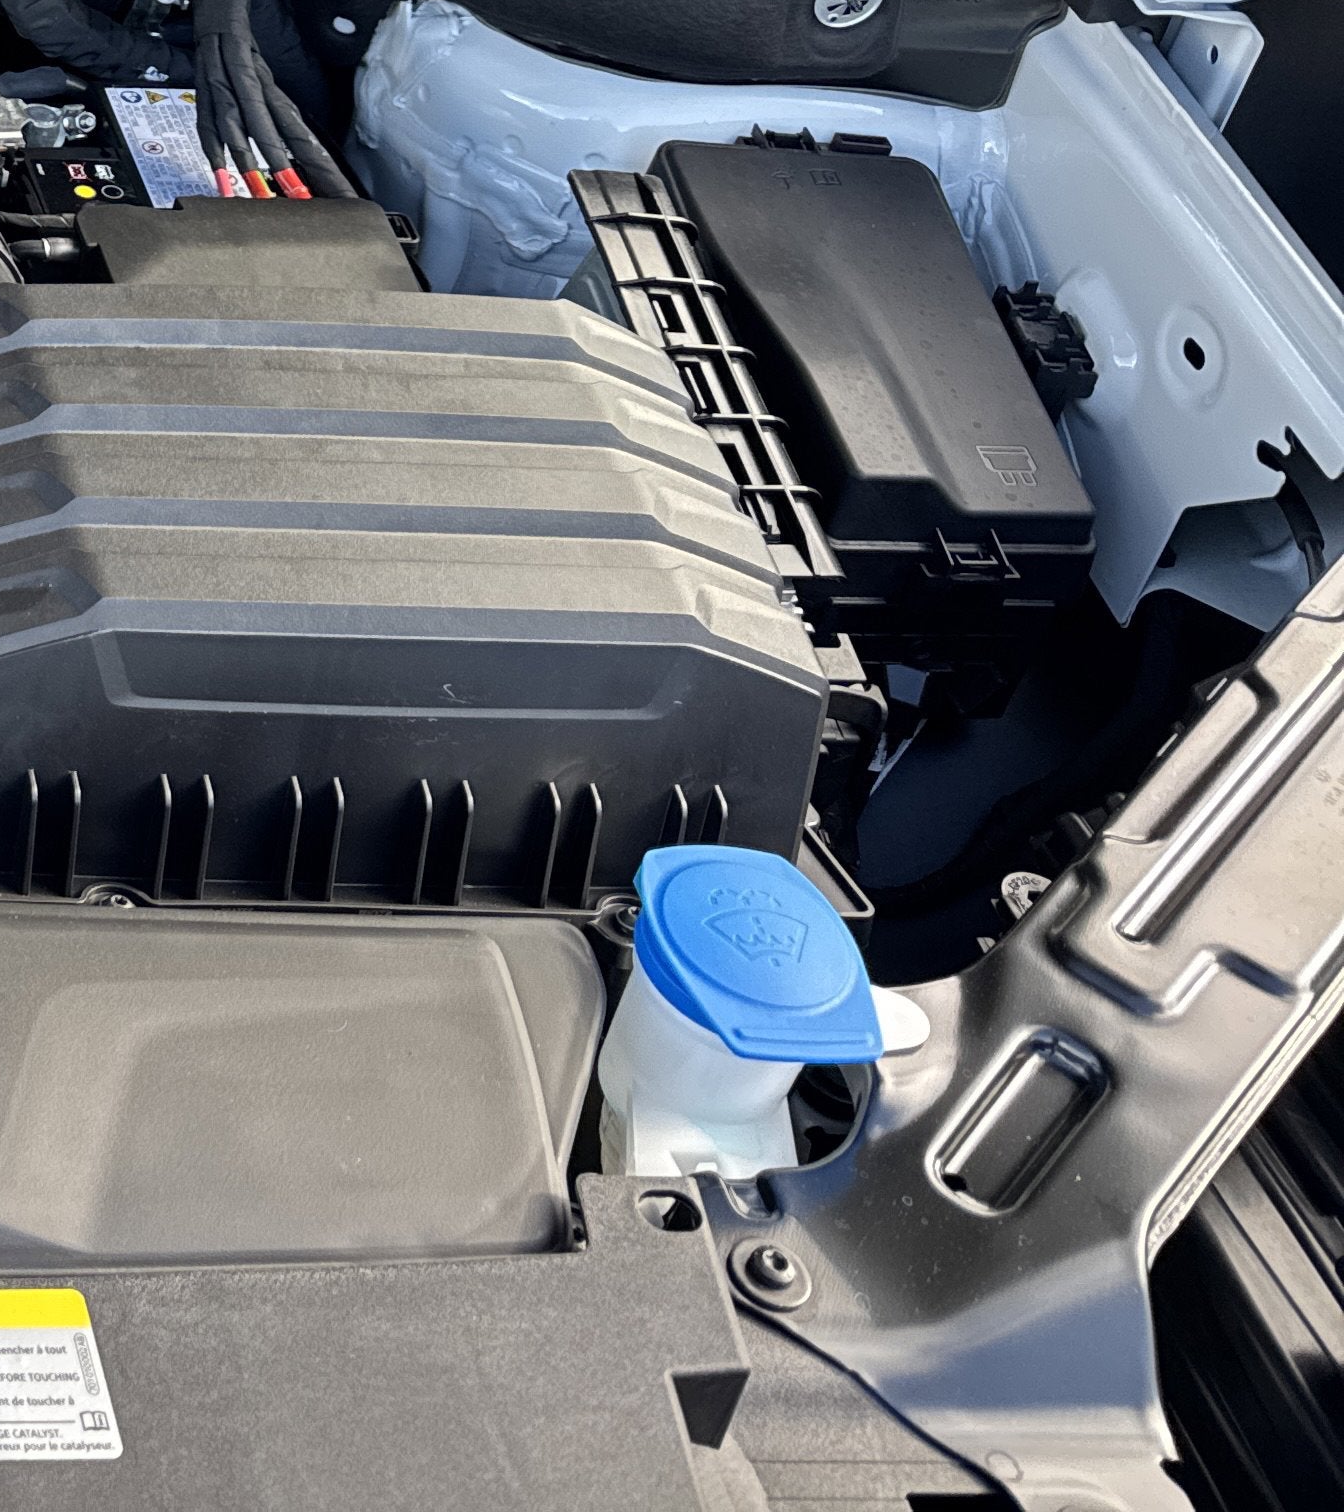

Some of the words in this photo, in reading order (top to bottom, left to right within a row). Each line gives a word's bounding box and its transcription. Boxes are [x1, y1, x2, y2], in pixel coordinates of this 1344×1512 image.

[37, 1344, 43, 1354] à
[45, 1345, 67, 1354] tout
[28, 1373, 80, 1382] TOUCHING
[12, 1396, 24, 1406] de
[27, 1395, 65, 1405] toucher
[68, 1395, 75, 1405] à
[12, 1429, 63, 1438] CATALYST.
[24, 1442, 46, 1452] pour
[49, 1441, 58, 1450] le
[60, 1440, 115, 1451] catalyseur.
